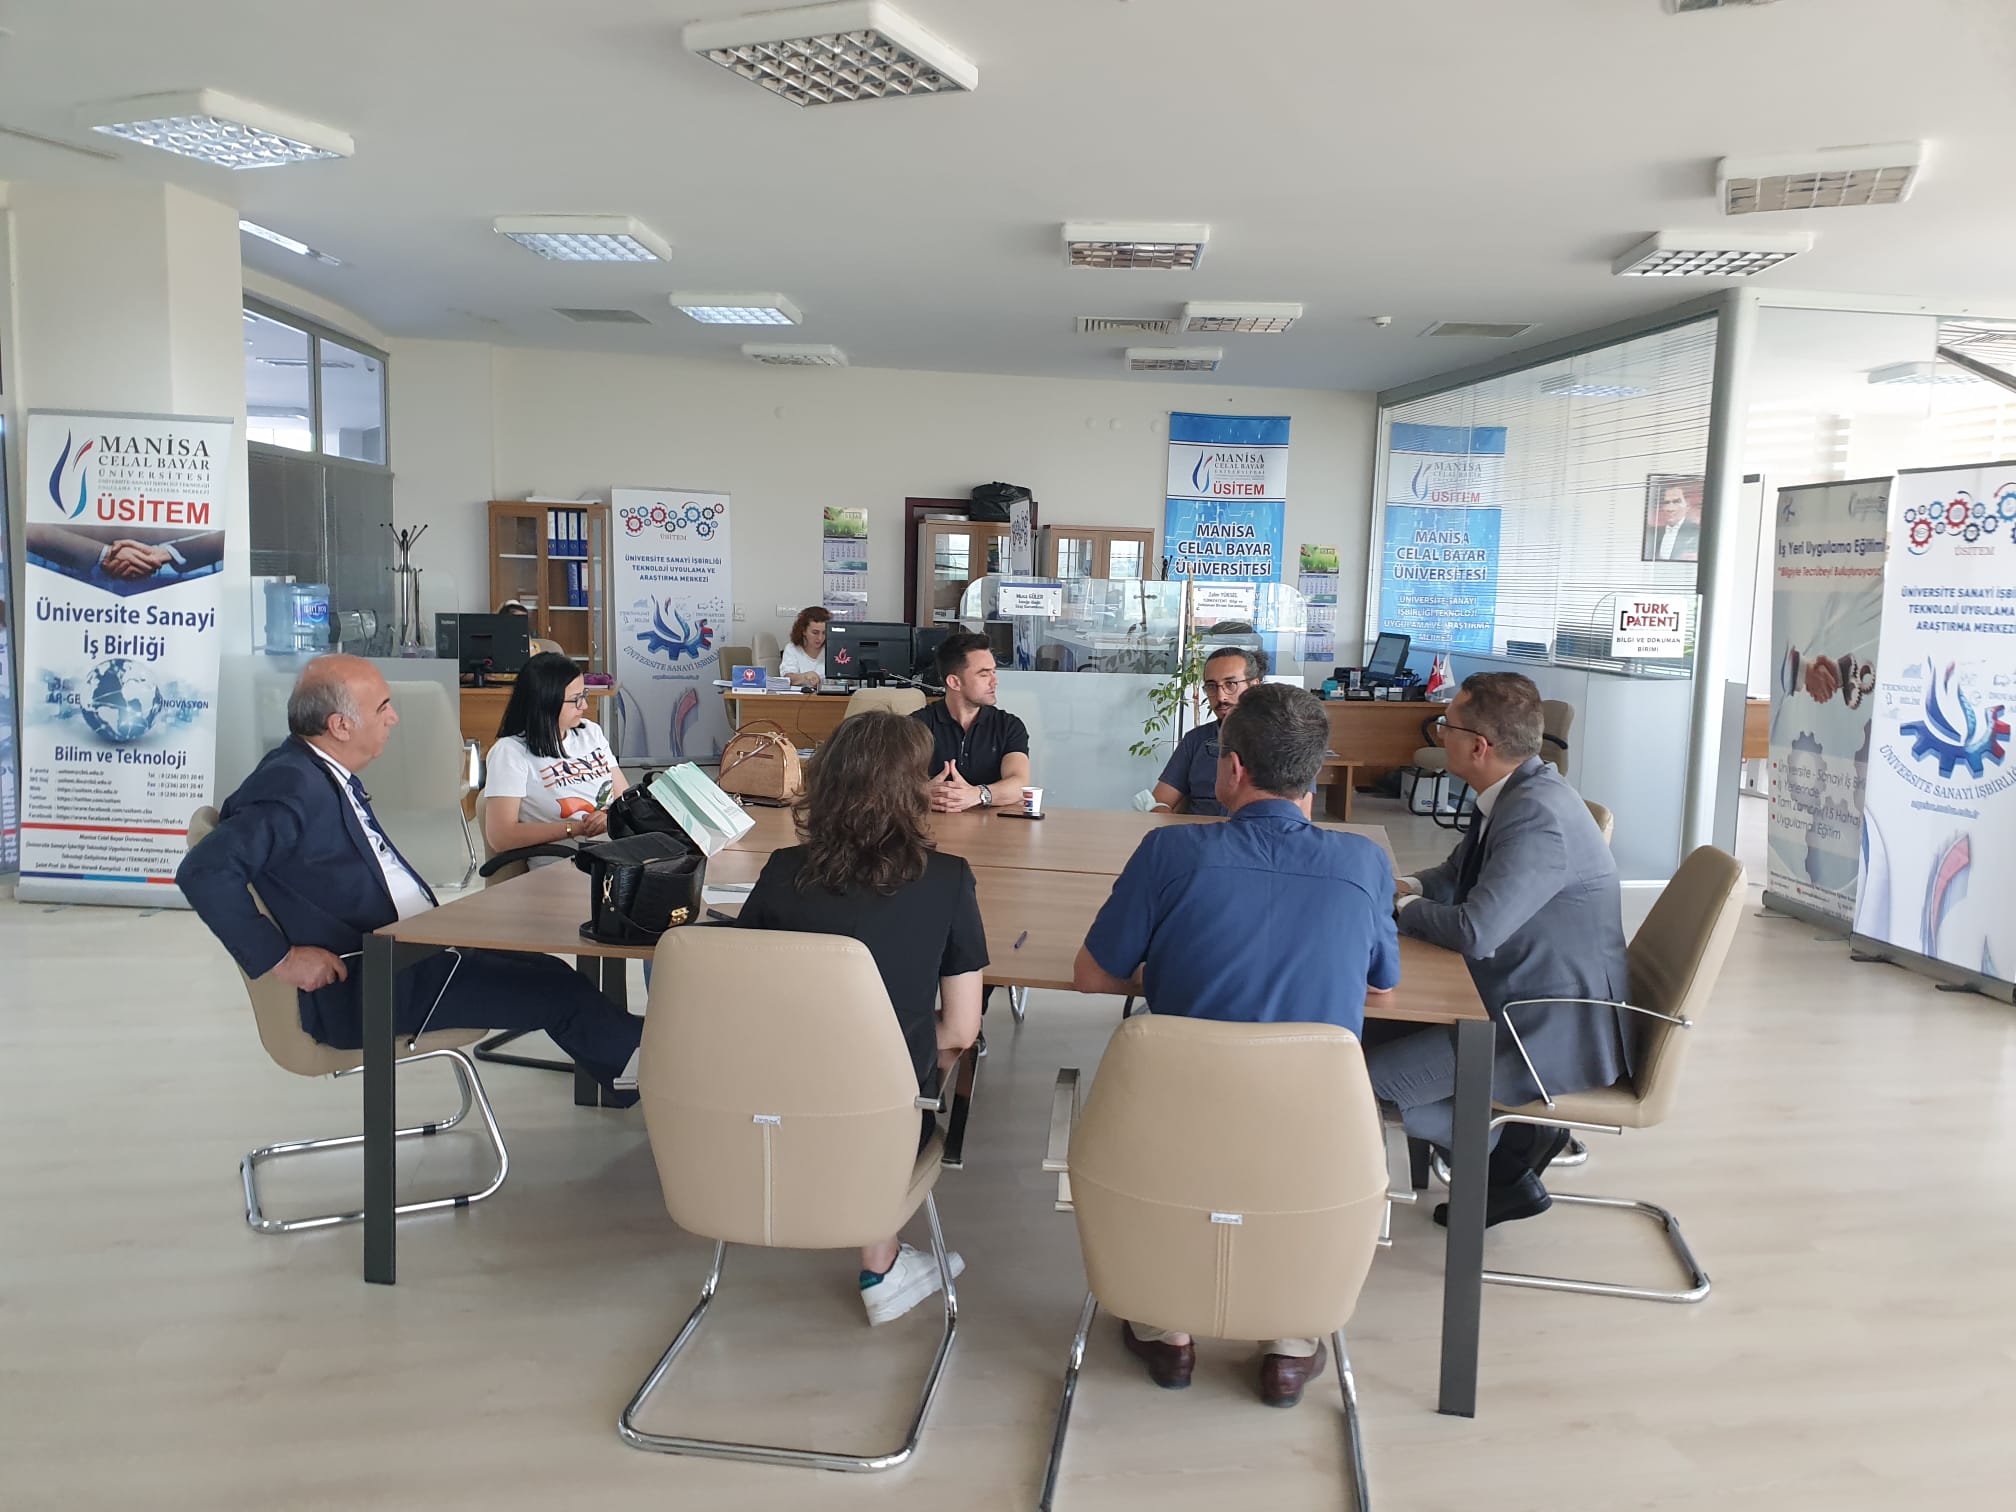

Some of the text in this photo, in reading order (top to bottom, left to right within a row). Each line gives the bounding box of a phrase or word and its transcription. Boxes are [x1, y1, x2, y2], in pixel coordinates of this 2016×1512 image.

[100, 433, 209, 457] MANİSA
[98, 455, 209, 470] CELAL BAYAR
[1215, 452, 1264, 463] MANİSA
[1213, 481, 1265, 496] ÜSİTEM
[97, 493, 209, 525] ÜSİTEM
[1197, 522, 1255, 538] MANİSA
[1415, 528, 1470, 544] MANİSA
[1178, 541, 1271, 556] CELAL BAYAR
[1396, 547, 1486, 561] CELAL BAYAR
[1788, 540, 1804, 555] Yeri
[1806, 540, 1852, 557] Uygulama
[625, 554, 664, 562] ÜNİVERSİTE
[692, 556, 722, 565] İŞBİRLİĞİ
[1175, 558, 1271, 575] ÜNİVERSİTESİ
[632, 564, 669, 572] TEKNOLOJİ
[1394, 564, 1486, 581] ÜNİVERSİTESİ
[1901, 585, 1956, 598] ÜNİVERSİTE
[1958, 586, 1994, 598] SANAYİ
[36, 596, 215, 633] Üniversite Sanayi
[1908, 602, 2015, 616] TEKNOLOJİ UYGULAMA
[1626, 616, 1675, 627] PATENT
[1916, 621, 1971, 633] ARAŞTIRMA
[84, 629, 165, 661] İş Birliği
[623, 645, 667, 671] ÜNİVERSİTE
[55, 746, 187, 770] Bilim ve Teknoloji
[1879, 744, 1933, 795] ÜNİVERSİTE
[1932, 784, 1974, 800] SANAYİ
[1817, 823, 1841, 840] Eğitim
